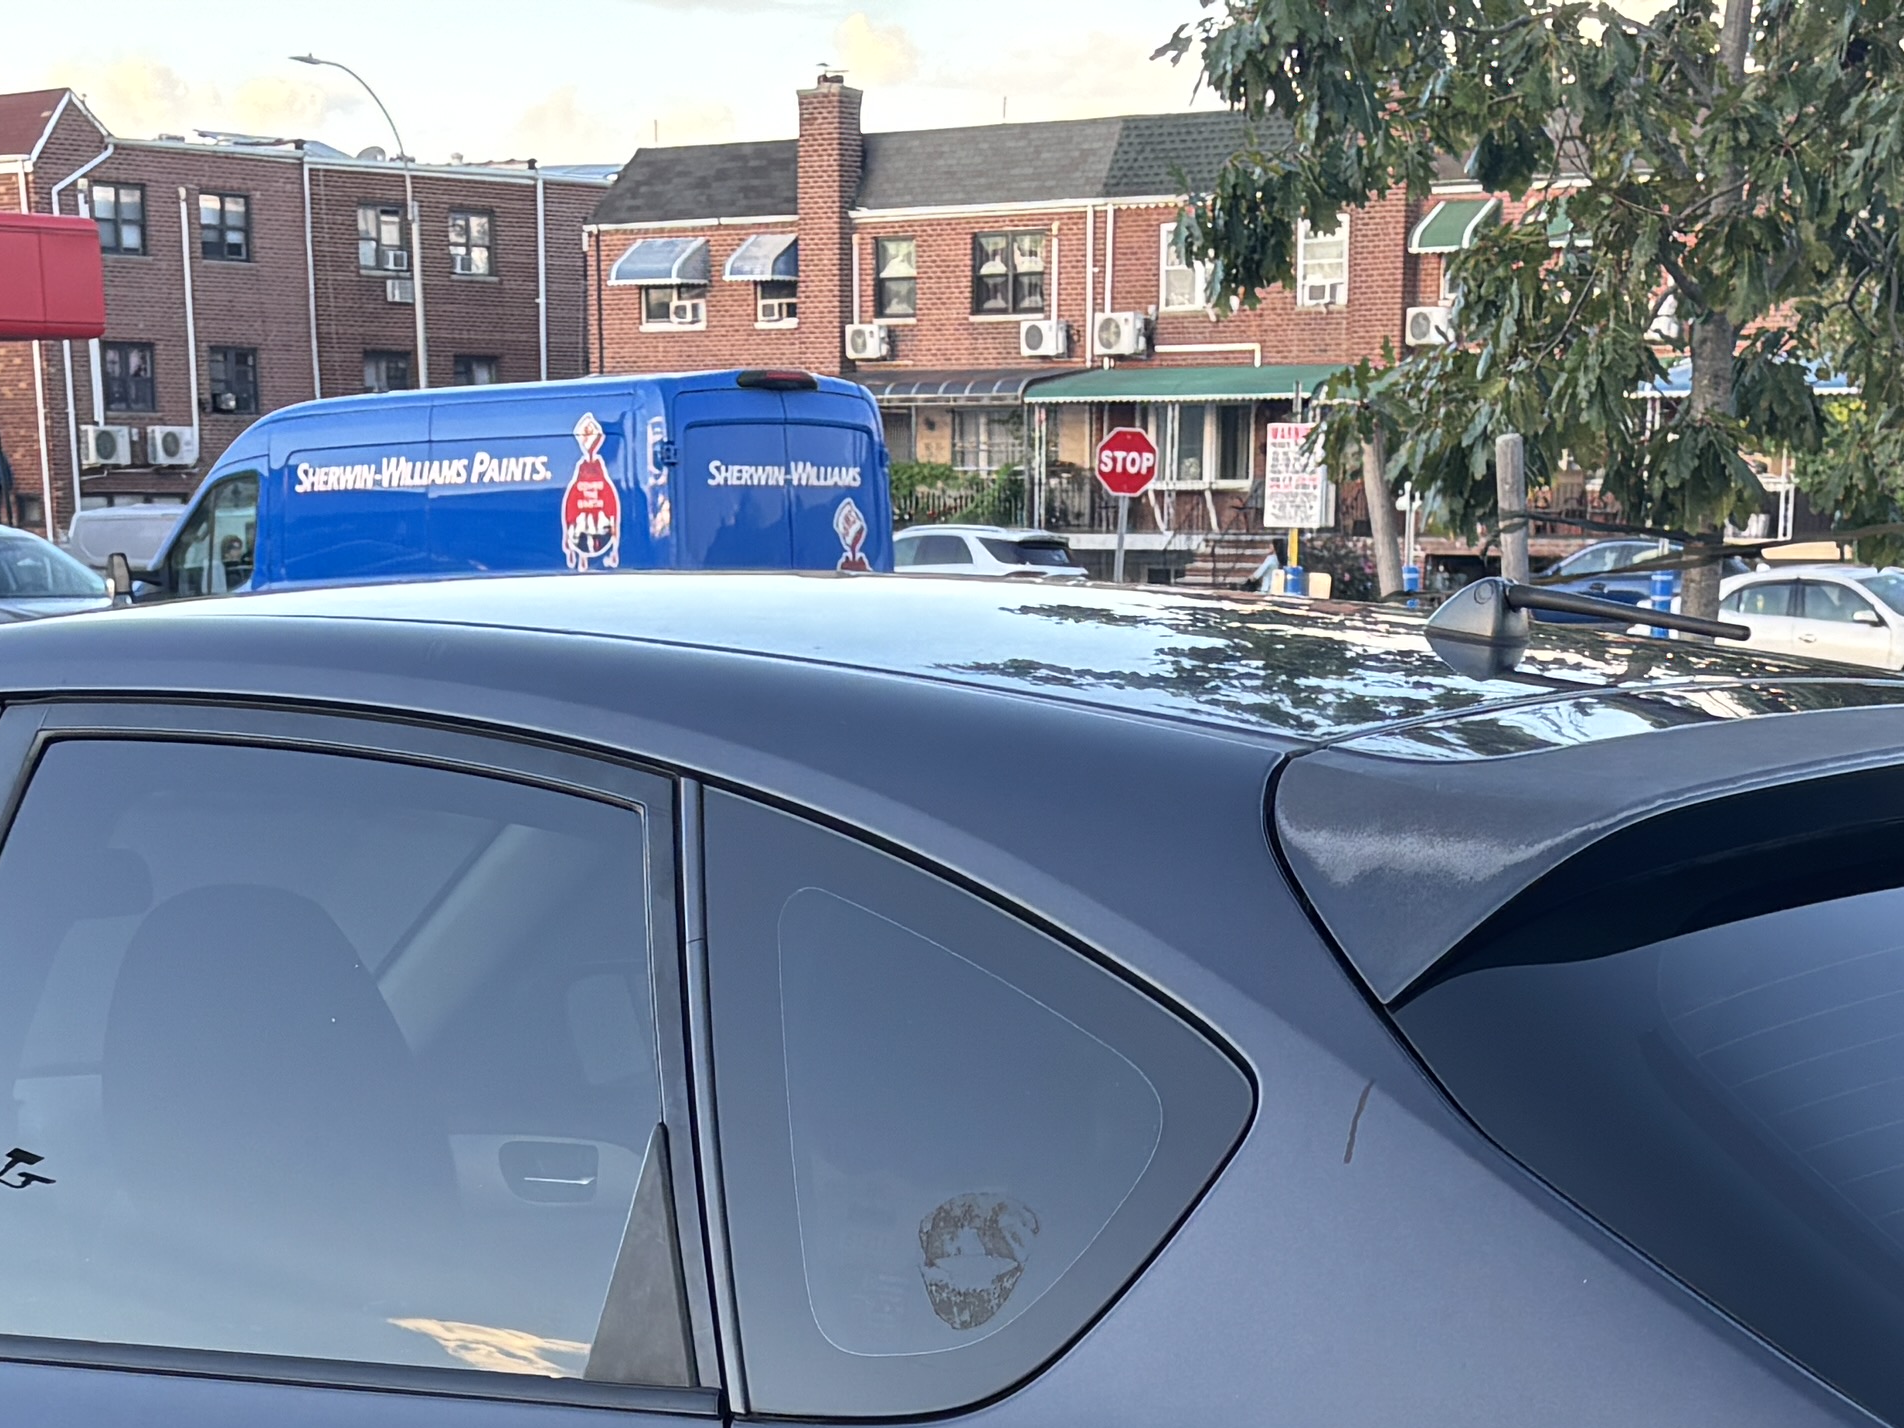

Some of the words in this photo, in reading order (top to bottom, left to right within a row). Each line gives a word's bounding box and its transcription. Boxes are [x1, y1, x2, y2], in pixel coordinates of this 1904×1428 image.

[295, 456, 469, 493] SHERWIN-WILLIAMS
[707, 460, 862, 487] SHERWIN-WILLIAMS
[1099, 450, 1155, 475] STOP
